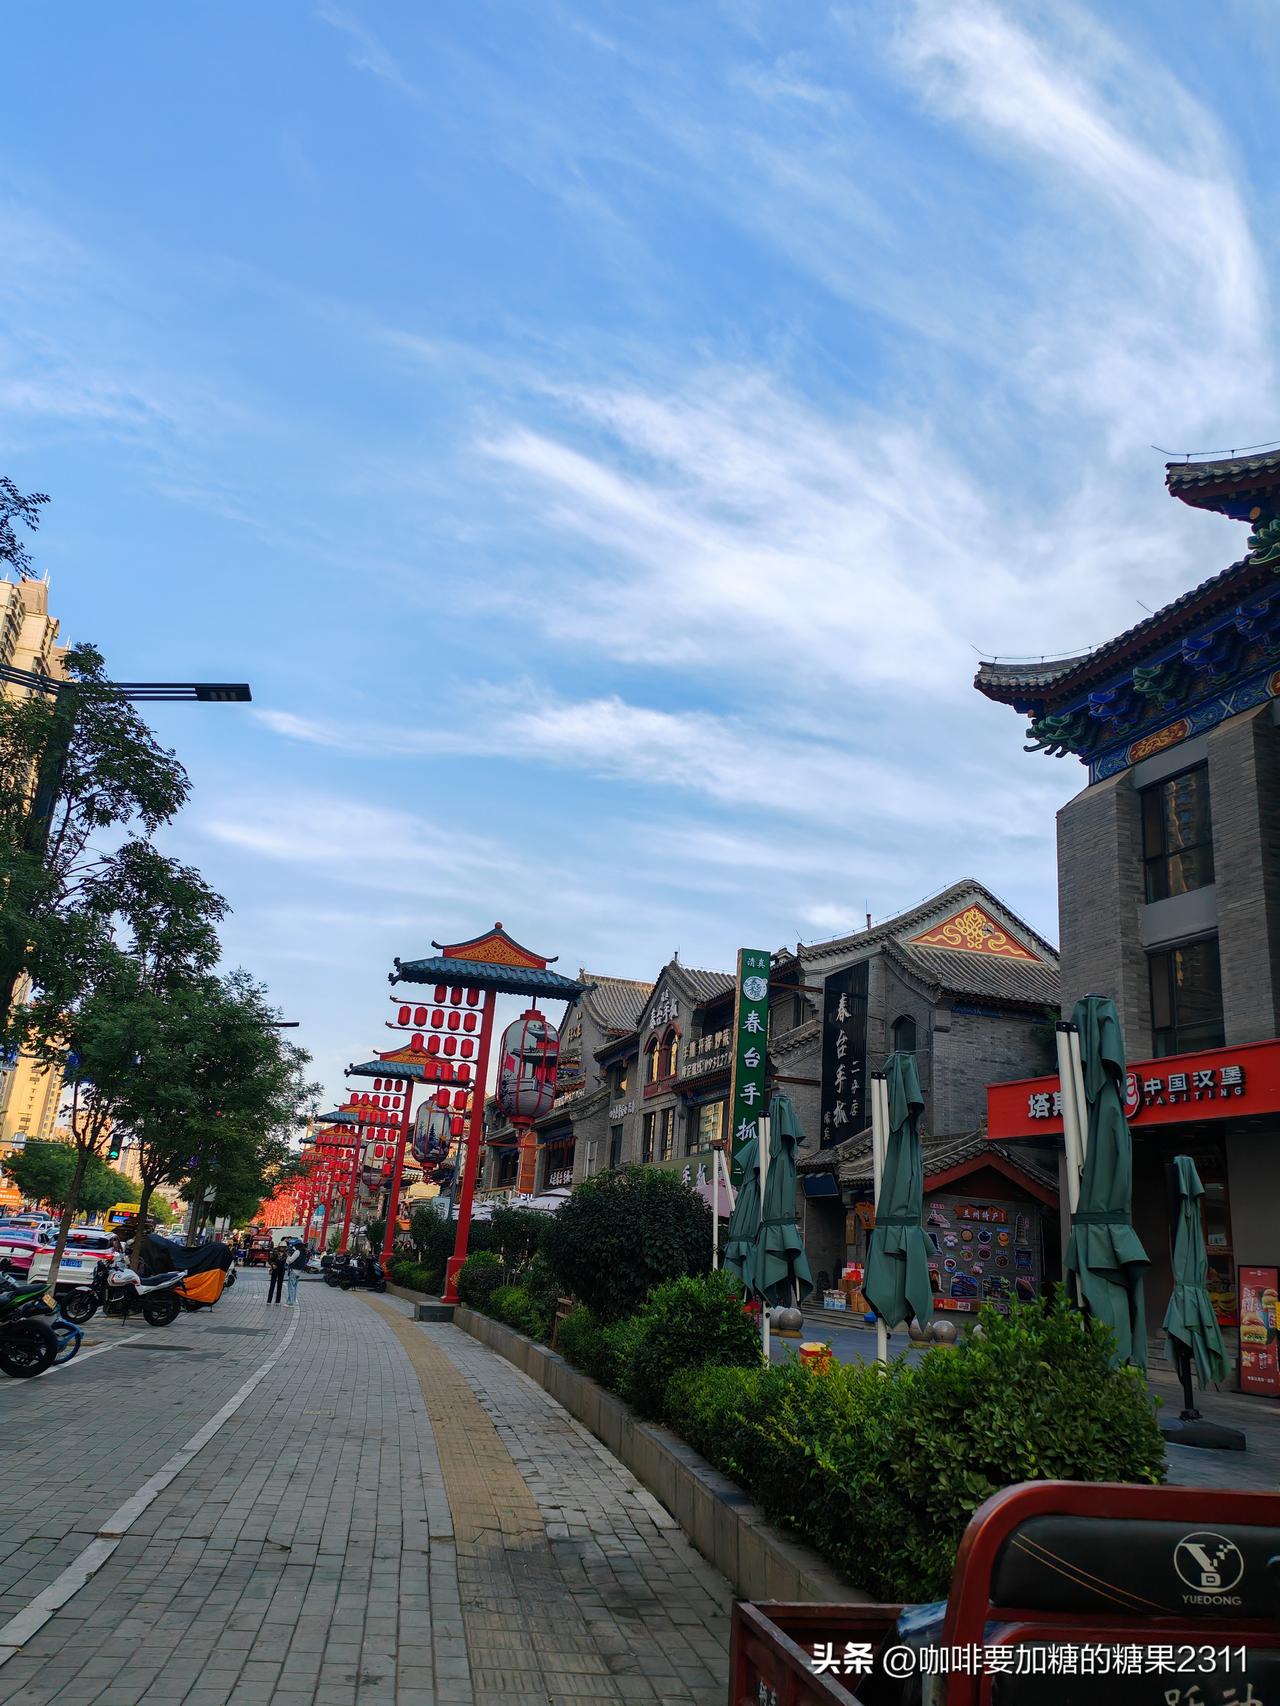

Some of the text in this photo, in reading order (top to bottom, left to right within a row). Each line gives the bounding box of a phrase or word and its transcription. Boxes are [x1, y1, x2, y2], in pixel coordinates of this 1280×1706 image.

[746, 958, 766, 969] 清真
[833, 992, 852, 1128] 春台手抓
[736, 1009, 766, 1142] 春台手抓
[1143, 1065, 1244, 1096] 中国汉堡
[1144, 1087, 1244, 1106] TASITING
[1182, 1594, 1243, 1607] YUEDONG
